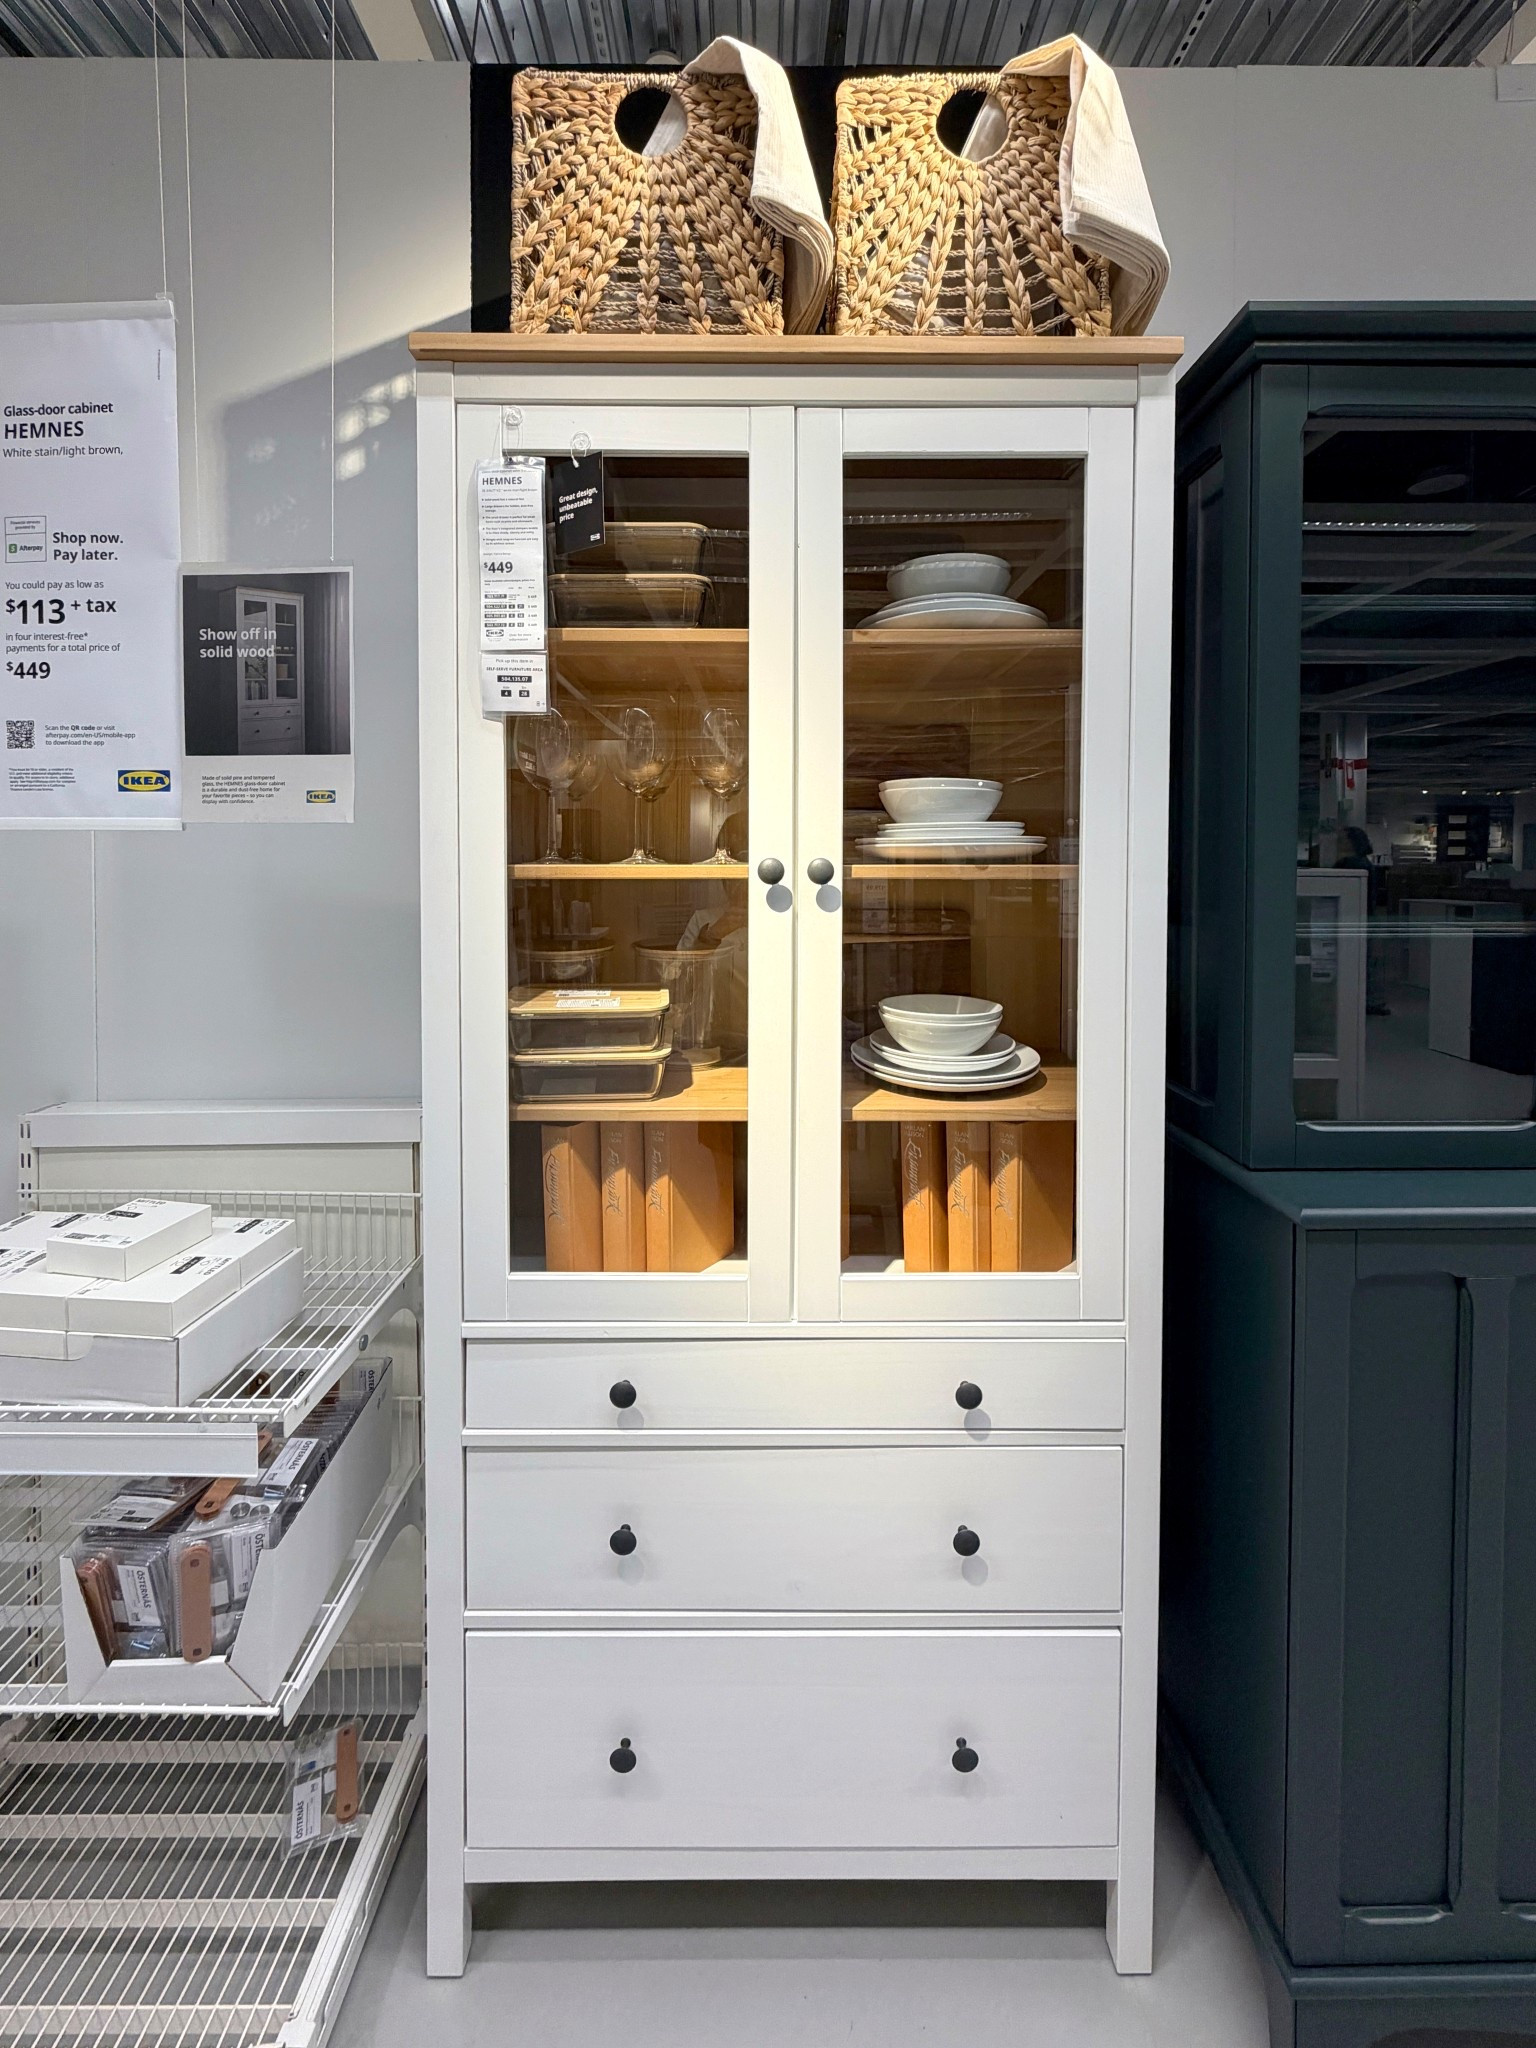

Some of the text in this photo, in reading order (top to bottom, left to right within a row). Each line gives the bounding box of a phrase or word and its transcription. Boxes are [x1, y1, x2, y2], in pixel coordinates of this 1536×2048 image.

[3, 402, 114, 417] Glass-door cabinet
[4, 420, 84, 440] HEMNES
[3, 445, 123, 458] White stain/light brown,
[482, 476, 523, 486] HEMNES
[559, 486, 598, 504] Great design,
[559, 497, 593, 513] unbeatable
[559, 512, 575, 525] price
[52, 531, 123, 547] Shop now.
[53, 548, 118, 563] Pay later.
[483, 561, 513, 574] $449
[5, 580, 104, 591] You could pay as low as
[5, 598, 117, 625] $113 + tax
[5, 632, 14, 641] in
[15, 632, 32, 641] four
[199, 627, 277, 641] Show off in
[5, 643, 120, 655] payments for a total price of
[200, 644, 275, 658] solid wood
[6, 661, 51, 679] $449
[288, 1440, 314, 1470] ÖSTERNÅS
[136, 1570, 152, 1609] ÖSTERNÅS
[295, 1800, 305, 1840] ÖSTERNÅS
